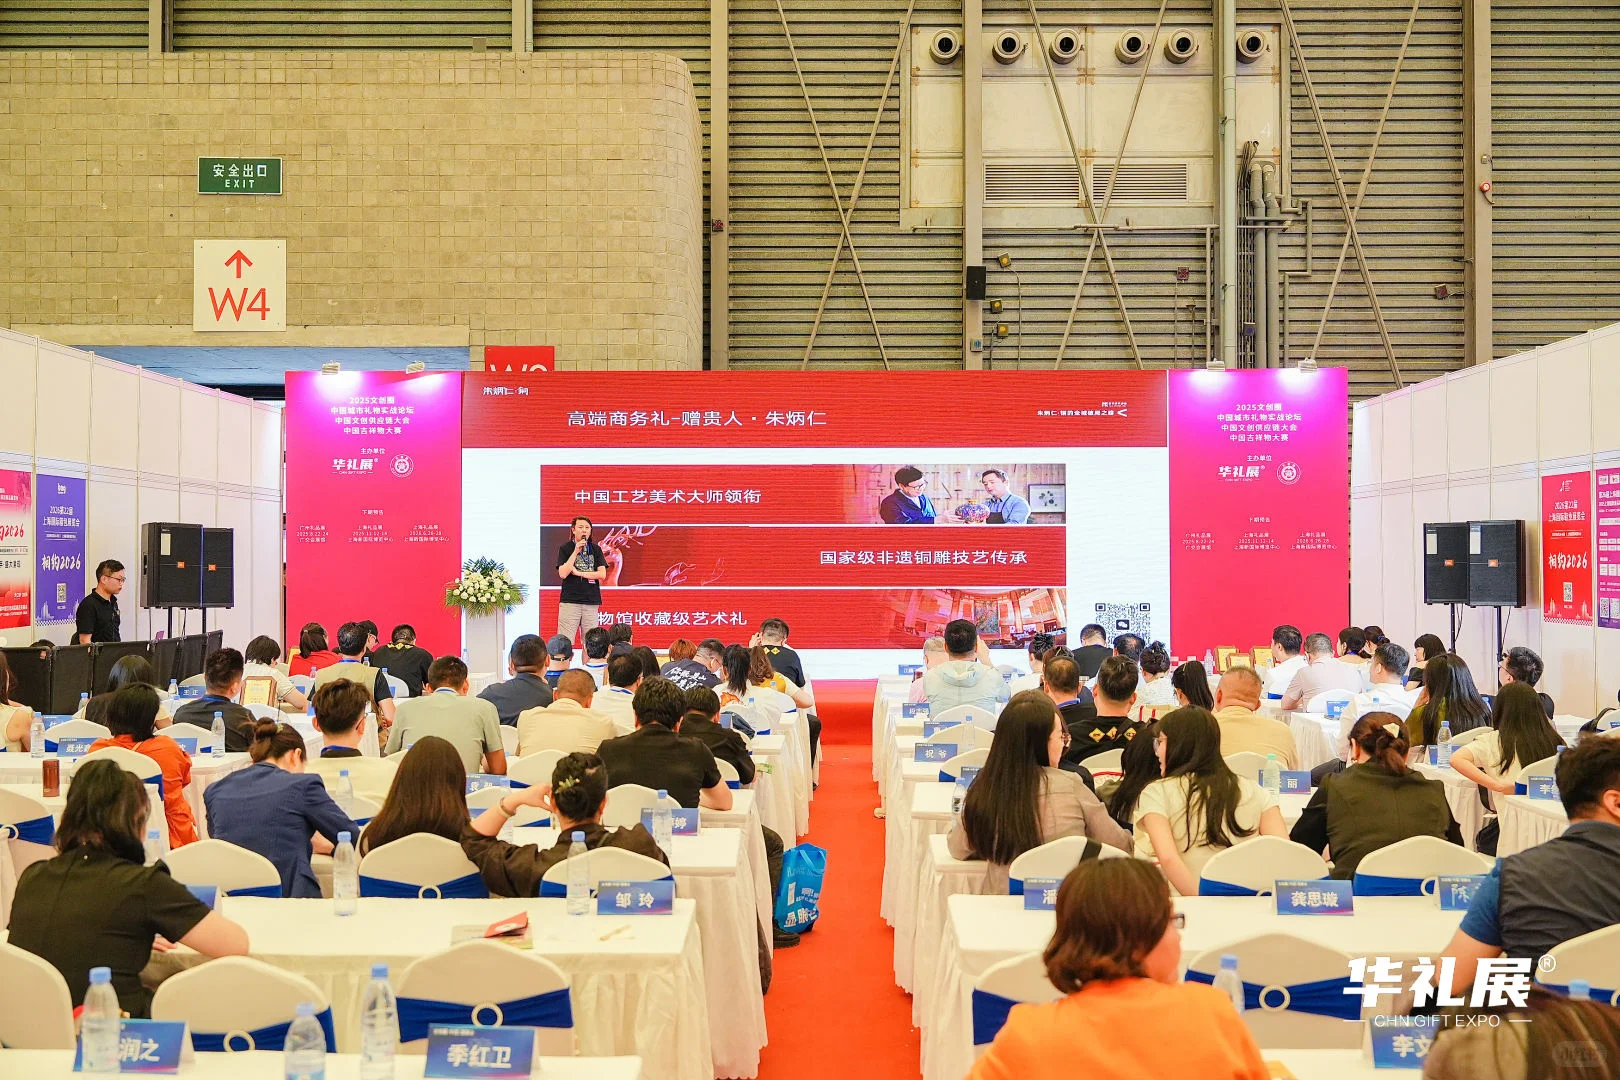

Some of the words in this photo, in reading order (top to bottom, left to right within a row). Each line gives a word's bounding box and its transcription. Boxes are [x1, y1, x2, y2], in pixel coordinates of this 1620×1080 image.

[213, 164, 267, 177] 安全出口
[225, 180, 254, 188] EXIT
[208, 287, 270, 322] W4
[331, 406, 415, 415] 中国城市礼物实战论坛
[1236, 403, 1282, 411] 2025文创圈
[335, 416, 410, 425] 中国文创供应链大会
[1217, 413, 1302, 421] 中国城市礼物实战论坛
[343, 426, 402, 435] 中国吉祥物大赛
[1221, 424, 1298, 432] 中国文创供应链大会
[1230, 434, 1289, 442] 中国吉祥物大赛
[332, 458, 373, 470] 华礼展
[1218, 466, 1260, 477] 华礼展
[574, 489, 762, 505] 中国工艺美术大师领衔
[41, 552, 81, 572] 相约2026
[820, 550, 1028, 566] 国家级非遗铜雕技艺传承
[1548, 552, 1588, 570] 相约2026
[598, 611, 748, 626] 物馆收藏级艺术礼
[616, 891, 655, 908] 邹玲
[119, 1037, 160, 1062] 润之
[1392, 1034, 1433, 1058] 李文
[446, 1043, 512, 1069] 季红卫
